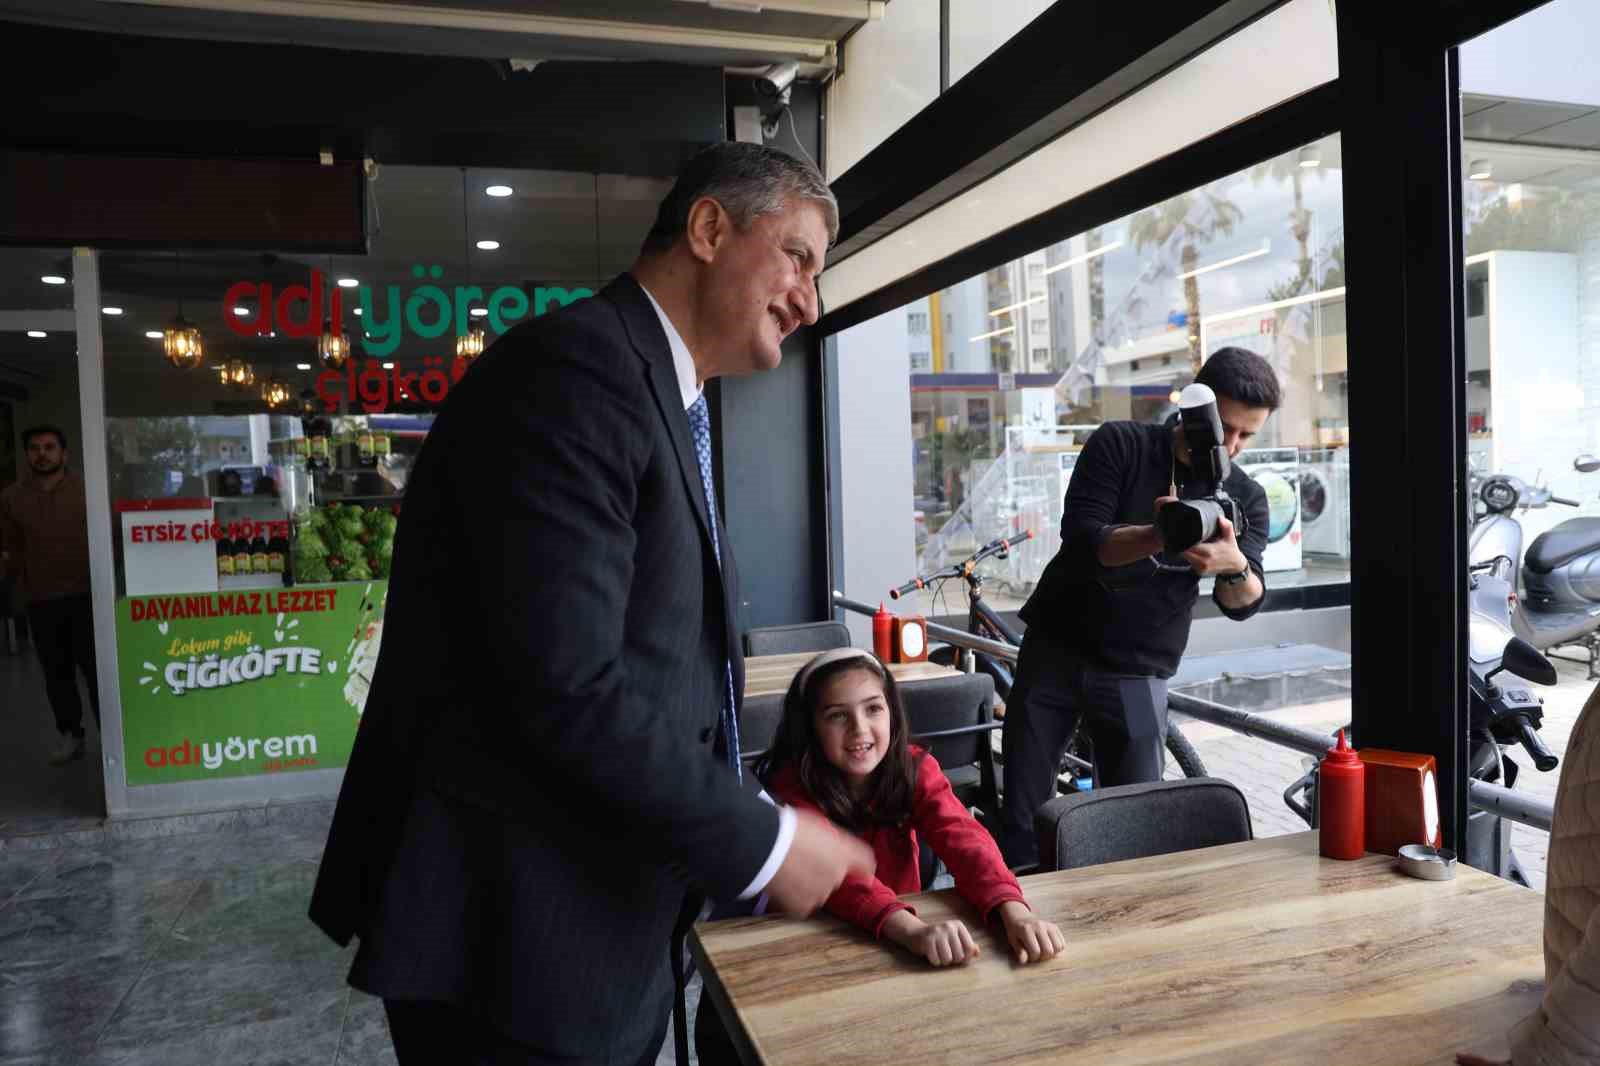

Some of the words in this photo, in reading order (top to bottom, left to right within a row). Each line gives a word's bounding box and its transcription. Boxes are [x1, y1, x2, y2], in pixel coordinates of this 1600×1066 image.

[131, 521, 185, 543] ETSİZ
[191, 519, 224, 543] ÇİĞ
[228, 516, 289, 540] KÖFTE
[131, 592, 262, 622] DAYANILMAZ
[266, 589, 337, 614] LEZZET
[167, 638, 220, 656] Lokum
[224, 630, 252, 651] gibi
[164, 645, 321, 695] ÇİĞKÖFTE
[144, 733, 318, 770] adıyörem
